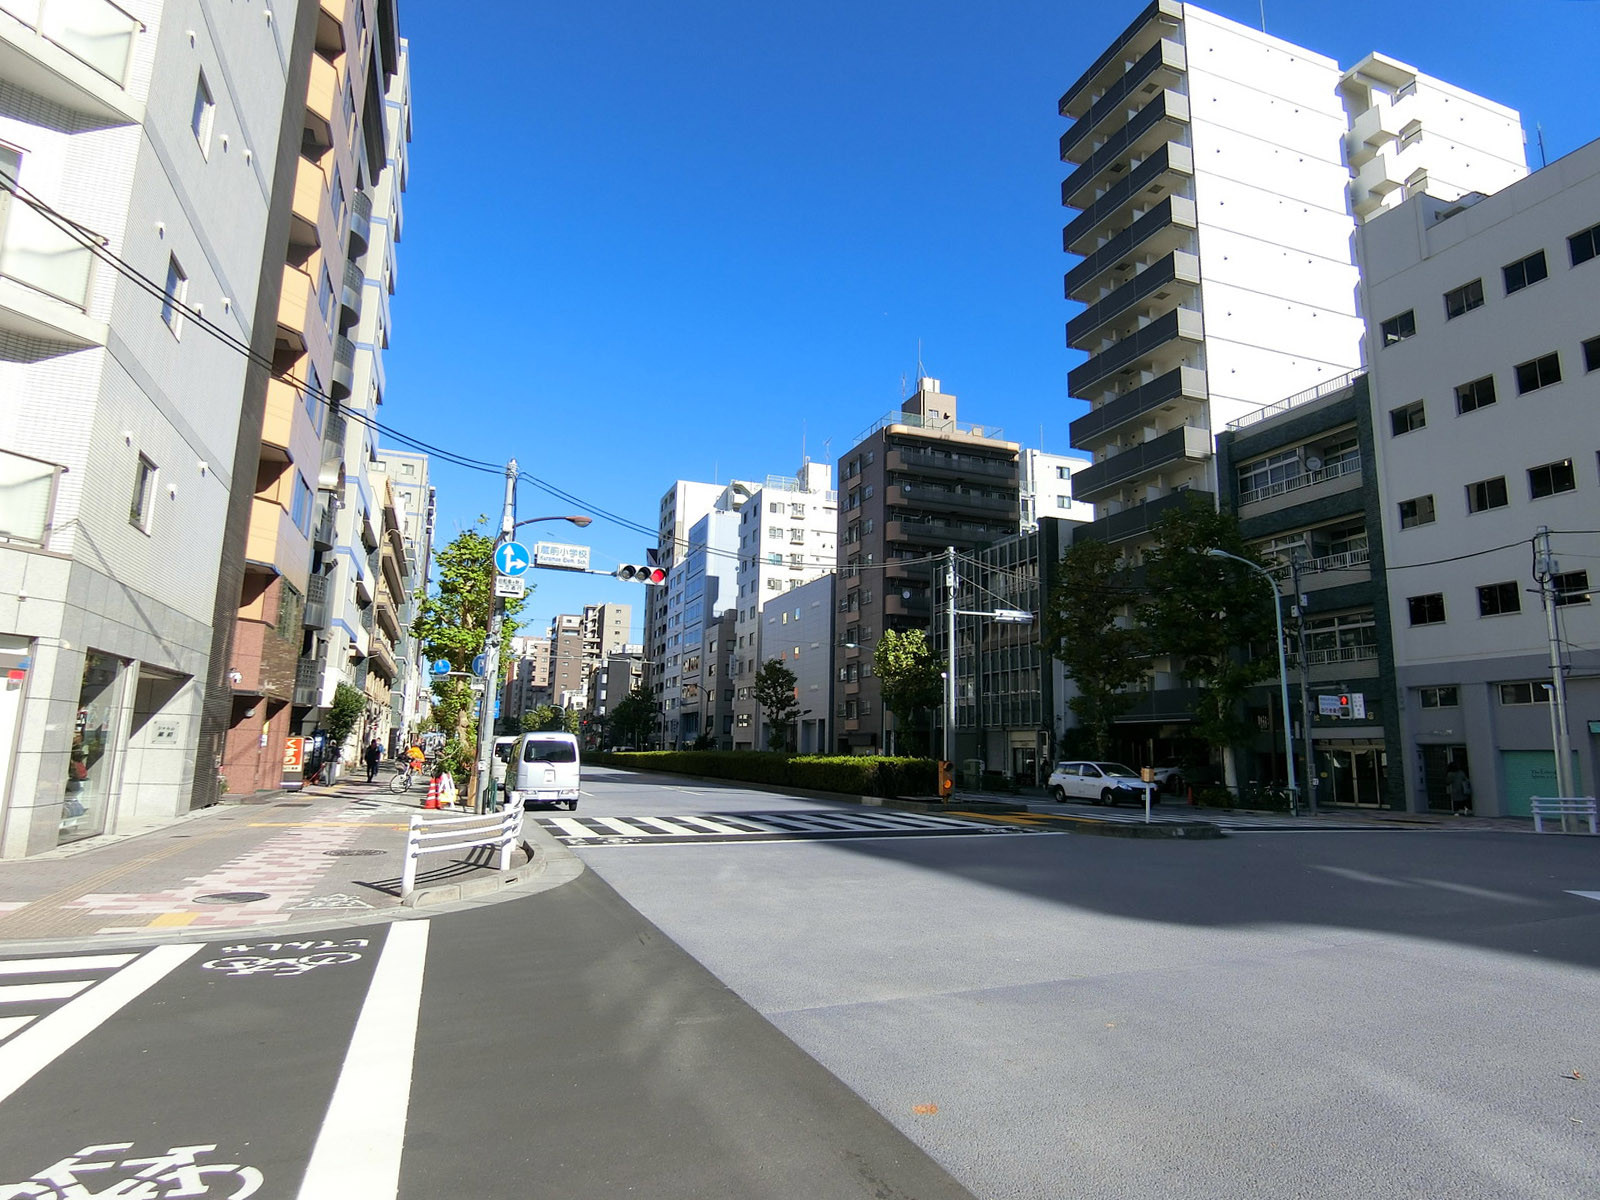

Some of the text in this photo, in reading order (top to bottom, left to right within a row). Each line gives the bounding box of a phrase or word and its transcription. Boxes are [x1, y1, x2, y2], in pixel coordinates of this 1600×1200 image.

[283, 739, 299, 765] くすり
[221, 939, 369, 953] じてんしゃ
